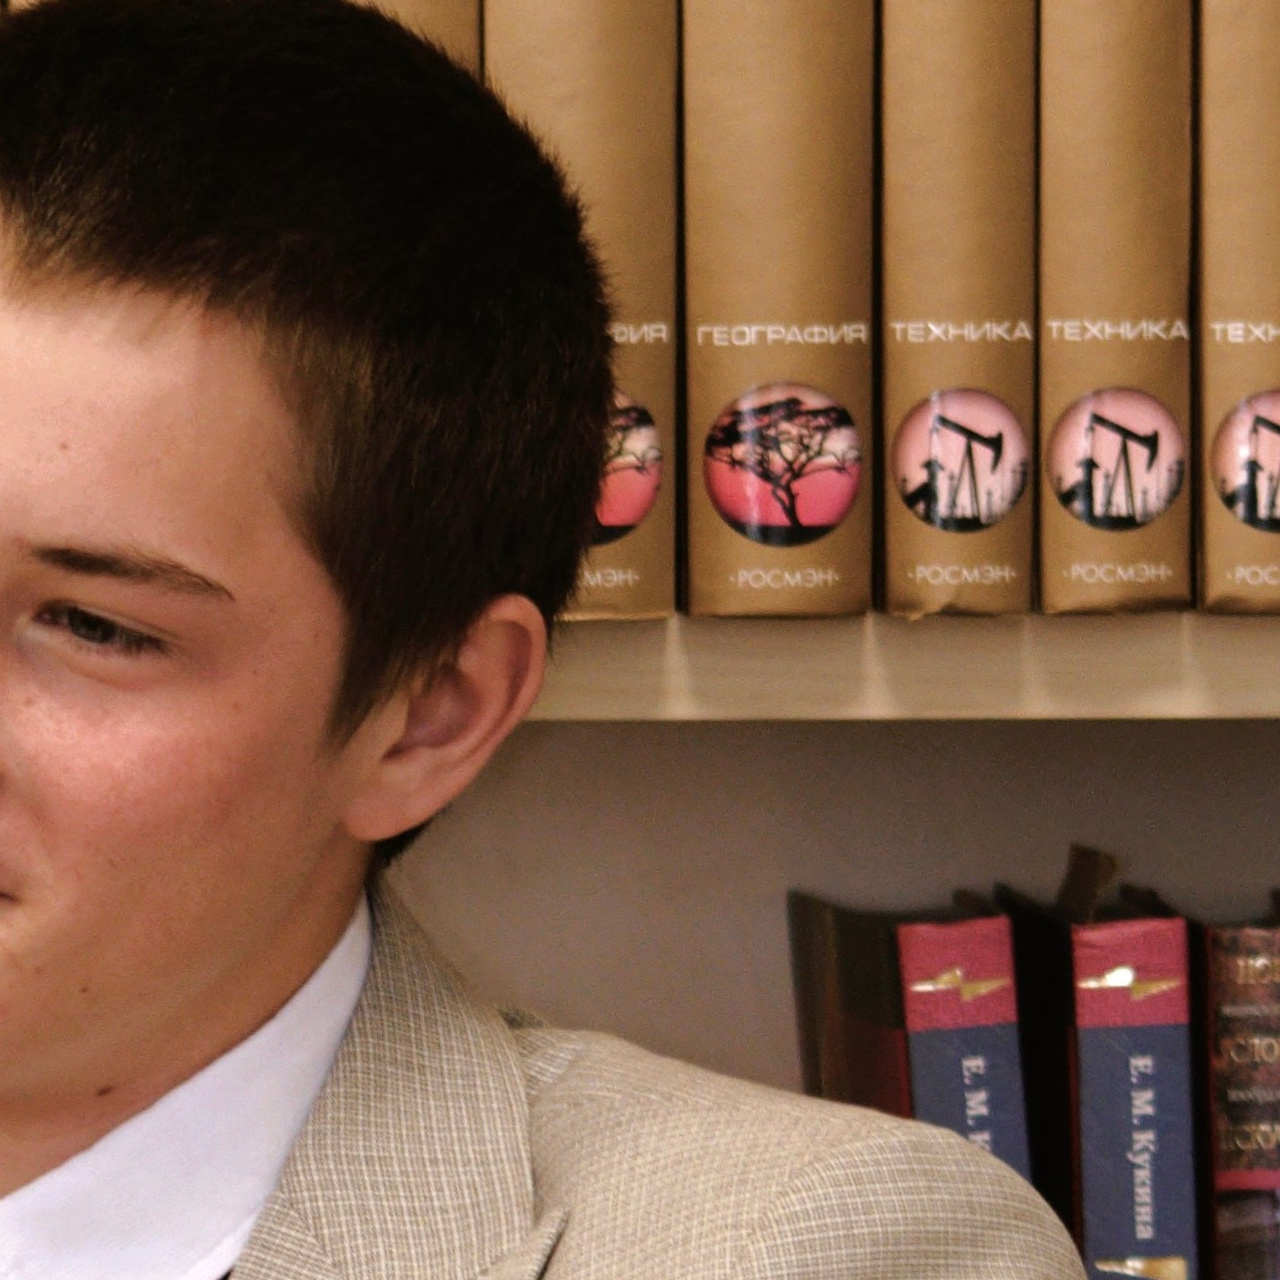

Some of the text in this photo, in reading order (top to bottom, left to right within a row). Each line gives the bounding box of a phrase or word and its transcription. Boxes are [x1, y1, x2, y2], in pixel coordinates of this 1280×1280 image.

[697, 321, 868, 346] ГЕОГРАФИЯ
[890, 320, 1033, 343] ТЕХНИКА
[1047, 318, 1190, 341] ТЕХНИКА
[1210, 320, 1280, 345] ТЕХН
